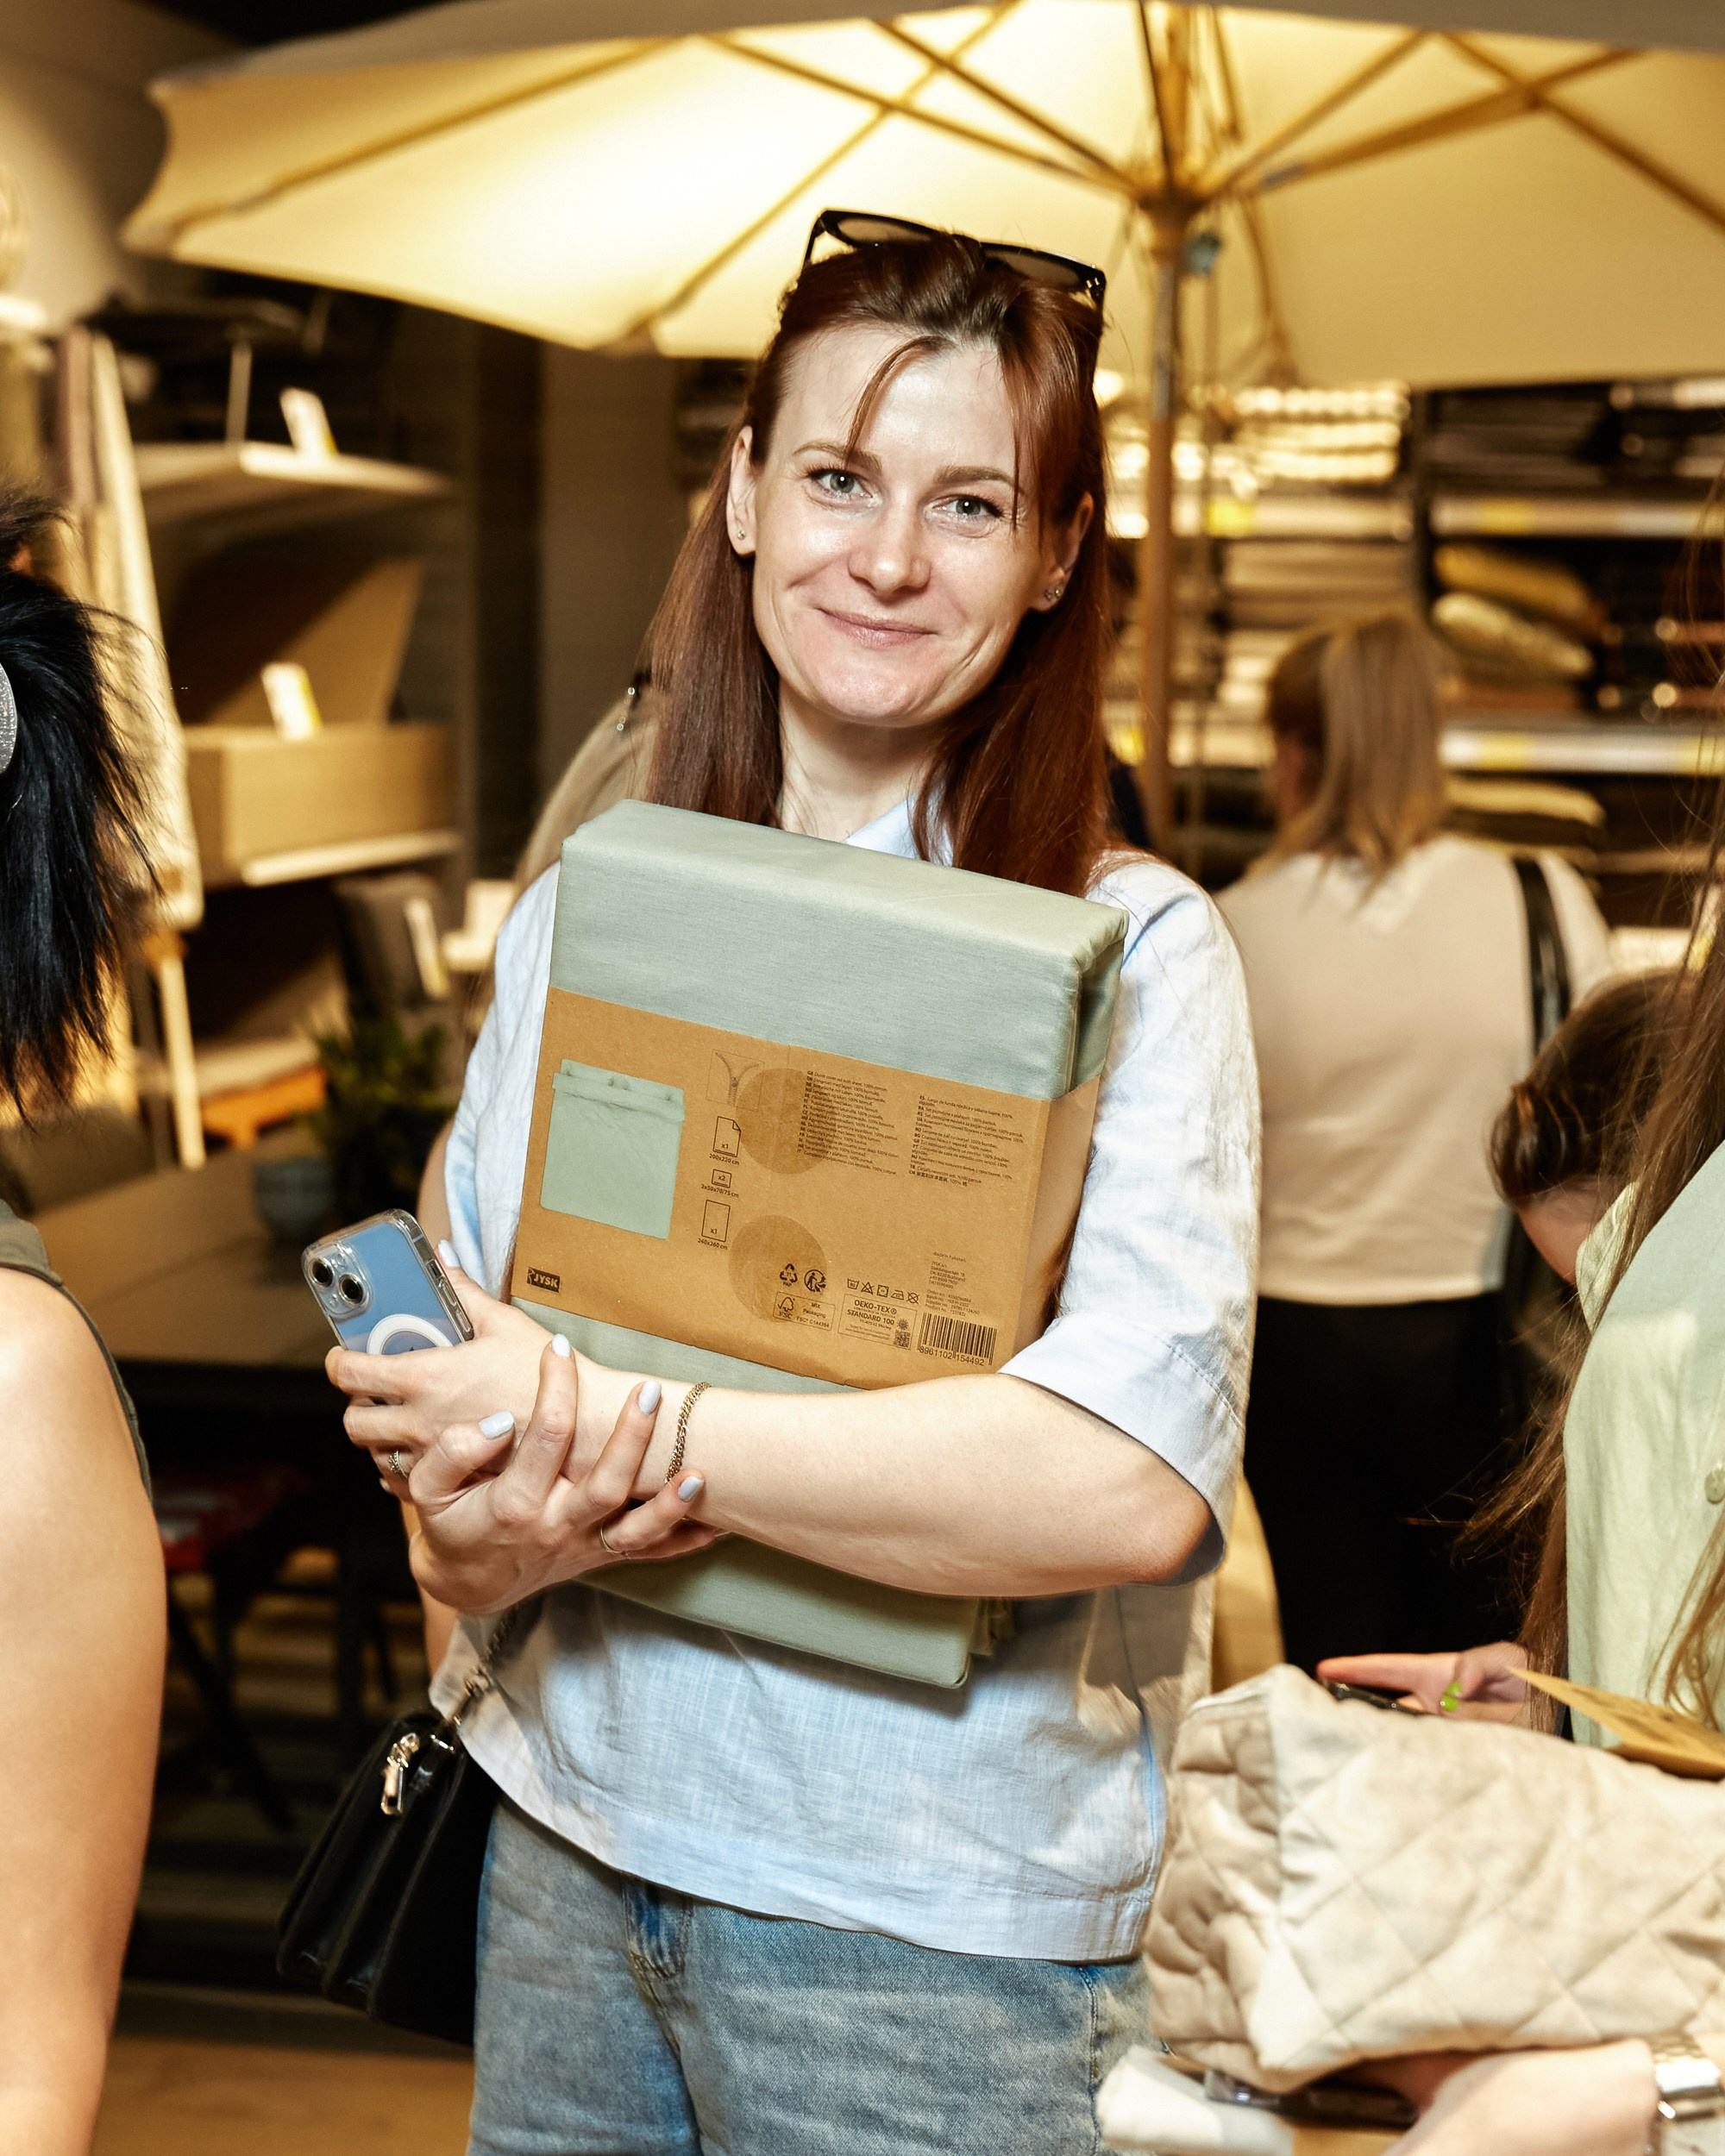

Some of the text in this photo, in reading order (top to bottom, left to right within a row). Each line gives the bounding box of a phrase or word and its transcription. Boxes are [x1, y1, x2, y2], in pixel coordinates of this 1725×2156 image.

[709, 1153, 731, 1163] 200x220
[700, 1184, 731, 1196] 2x50x70/75
[697, 1238, 719, 1248] 240x260
[533, 1273, 558, 1288] JYSK
[779, 1311, 793, 1319] FSC
[803, 1308, 826, 1319] Packaging
[847, 1309, 881, 1322] STANDARD
[957, 1354, 985, 1366] 154492
